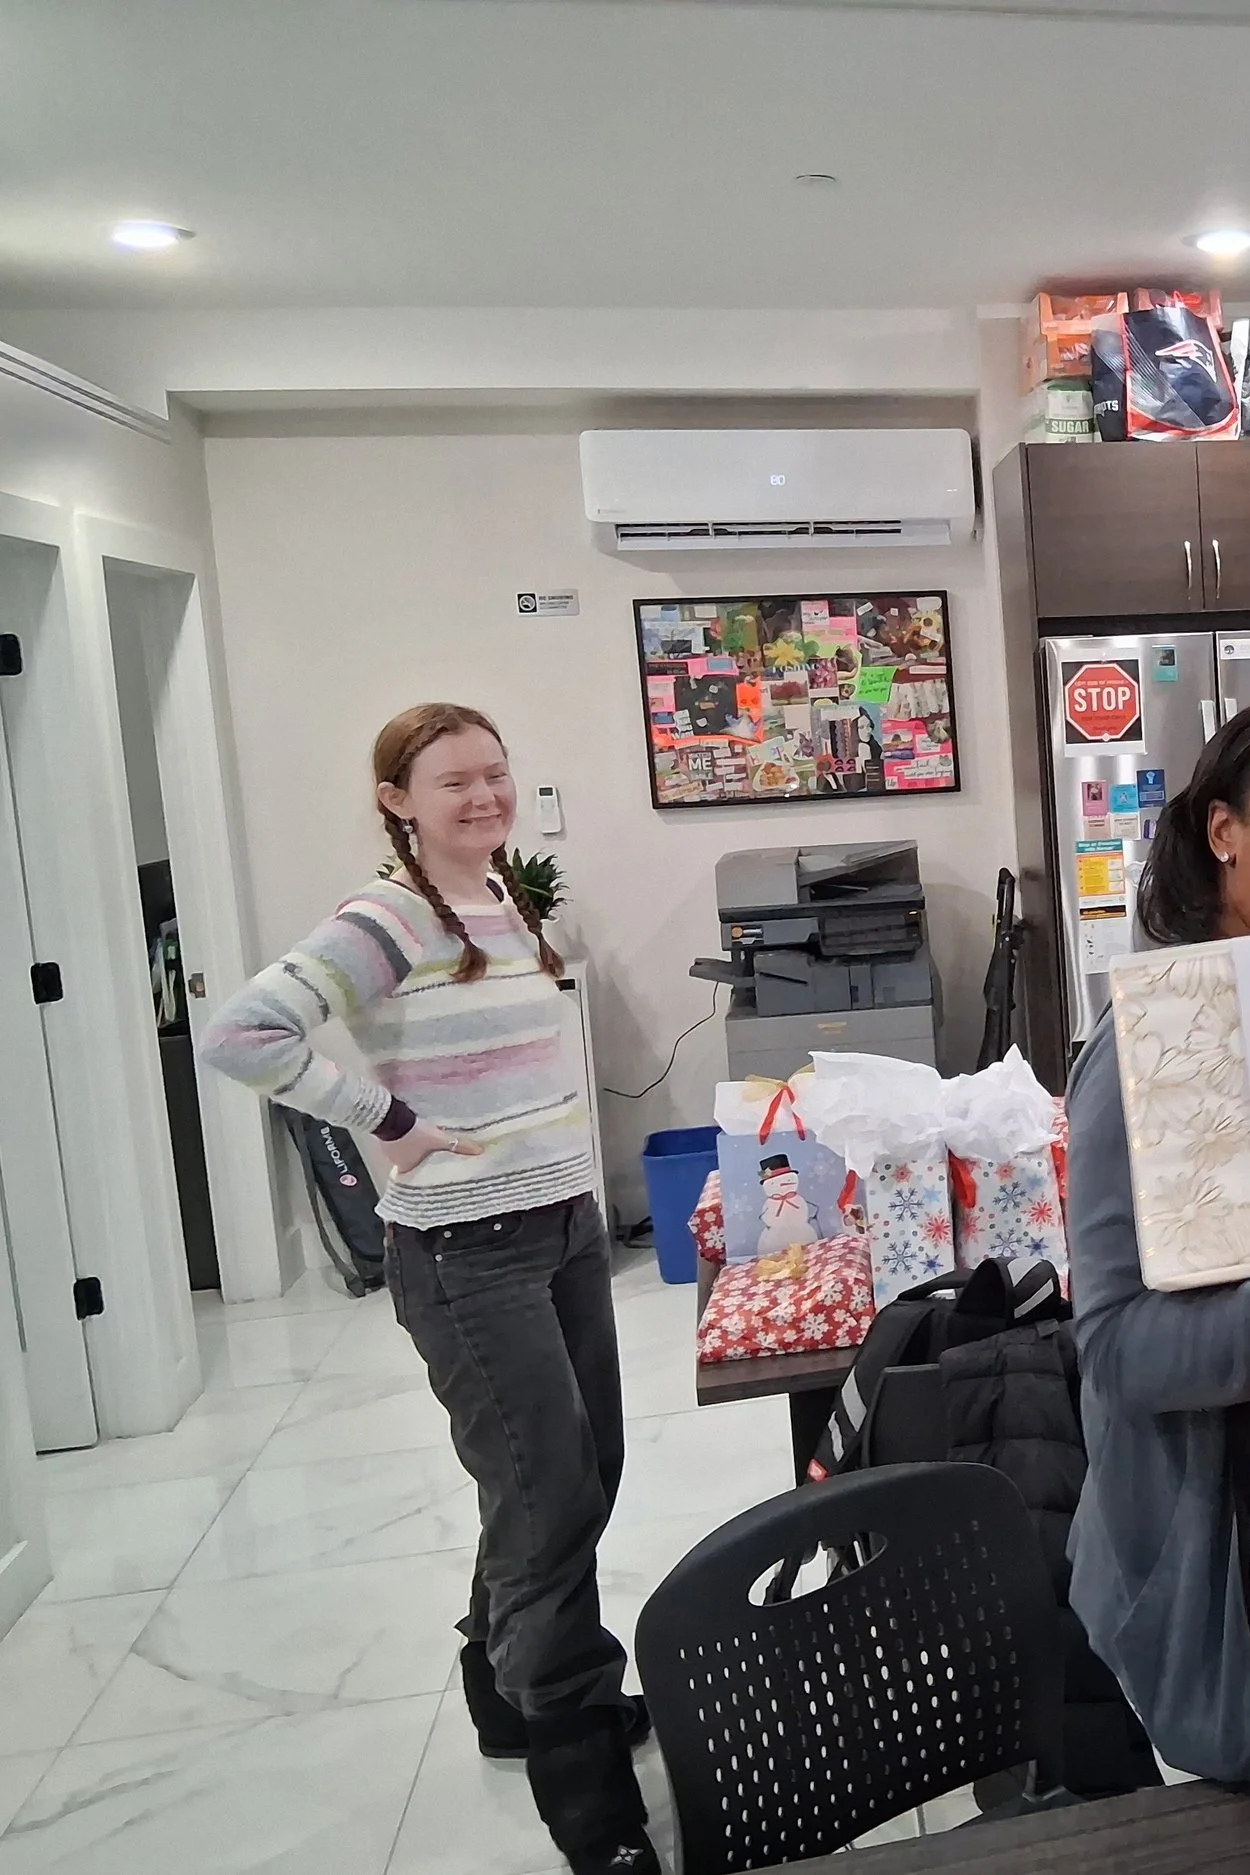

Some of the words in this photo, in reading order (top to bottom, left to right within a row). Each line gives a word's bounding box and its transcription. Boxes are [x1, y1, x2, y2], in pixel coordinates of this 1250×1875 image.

[1051, 420, 1090, 433] SUGAR
[1073, 686, 1131, 712] STOP
[688, 757, 712, 771] ME
